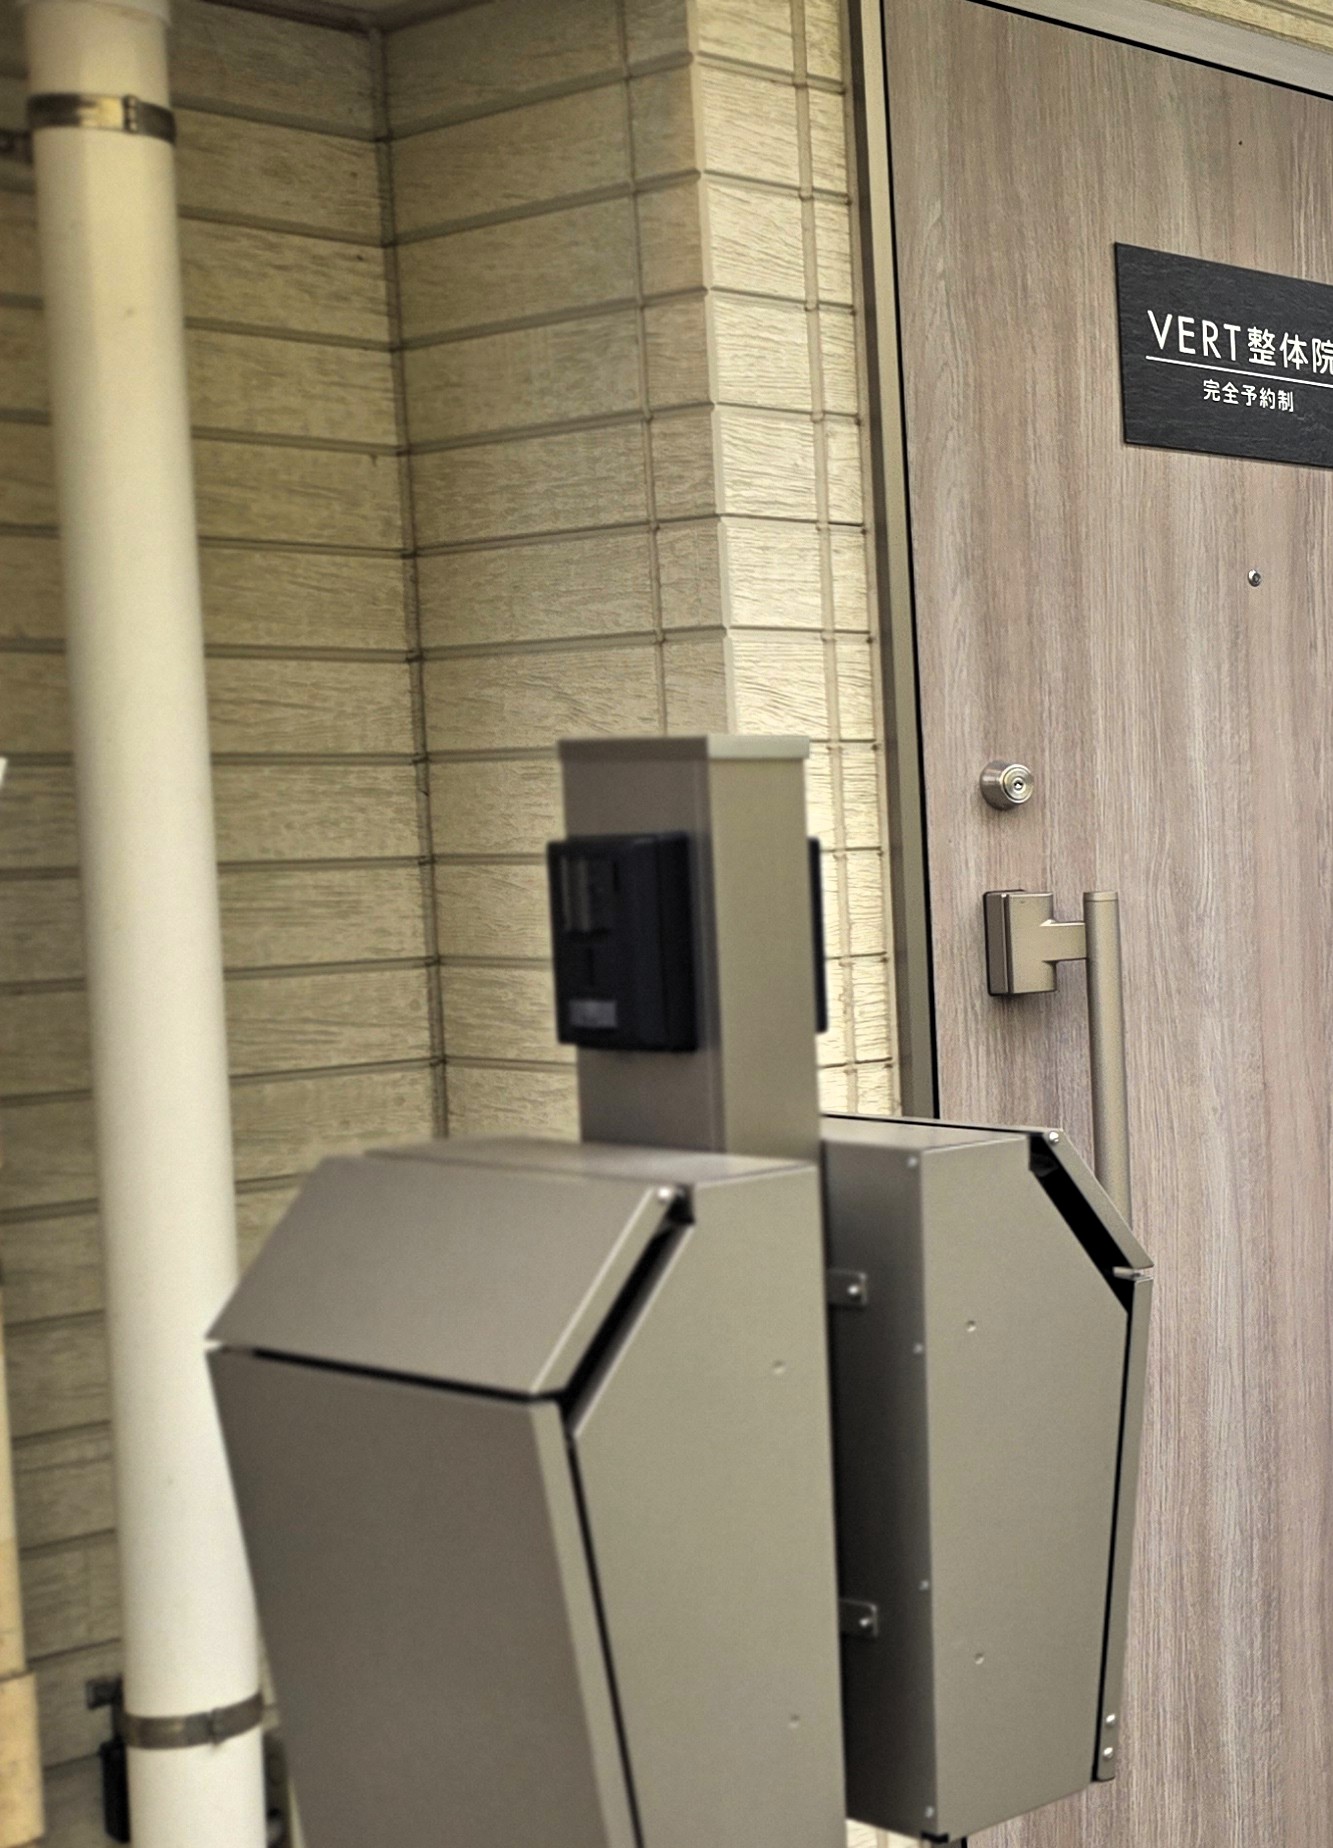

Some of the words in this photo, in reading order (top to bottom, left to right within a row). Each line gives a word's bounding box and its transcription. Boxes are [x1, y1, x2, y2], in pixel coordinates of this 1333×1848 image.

[1202, 378, 1295, 413] 完全予約制
